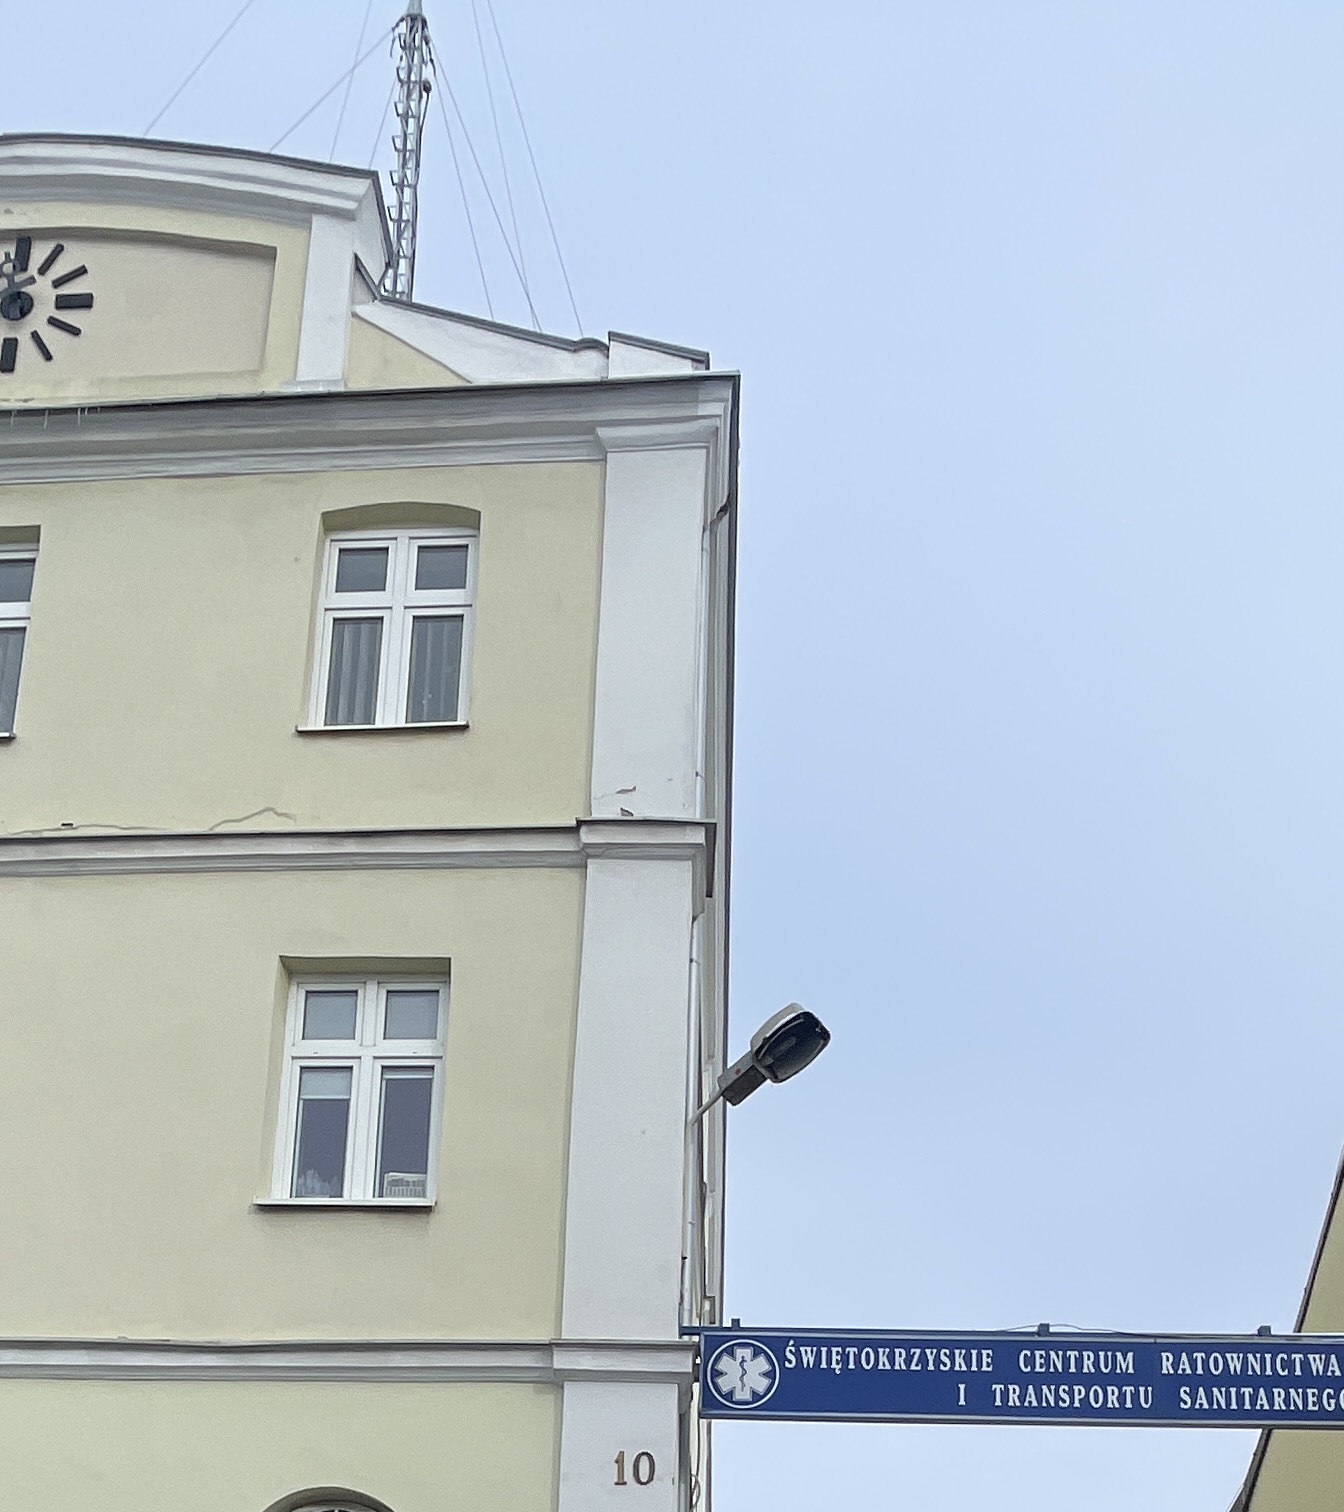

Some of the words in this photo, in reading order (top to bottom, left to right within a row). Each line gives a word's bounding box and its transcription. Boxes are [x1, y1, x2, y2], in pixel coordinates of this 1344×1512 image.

[784, 1340, 993, 1374] ŚWIĘTOKRZYSKIE
[1018, 1349, 1135, 1374] CENTRUM
[1161, 1352, 1342, 1377] RATOWNICTWA
[958, 1383, 967, 1405] I
[992, 1384, 1153, 1408] TRANSPORTU
[614, 1450, 656, 1486] 10
